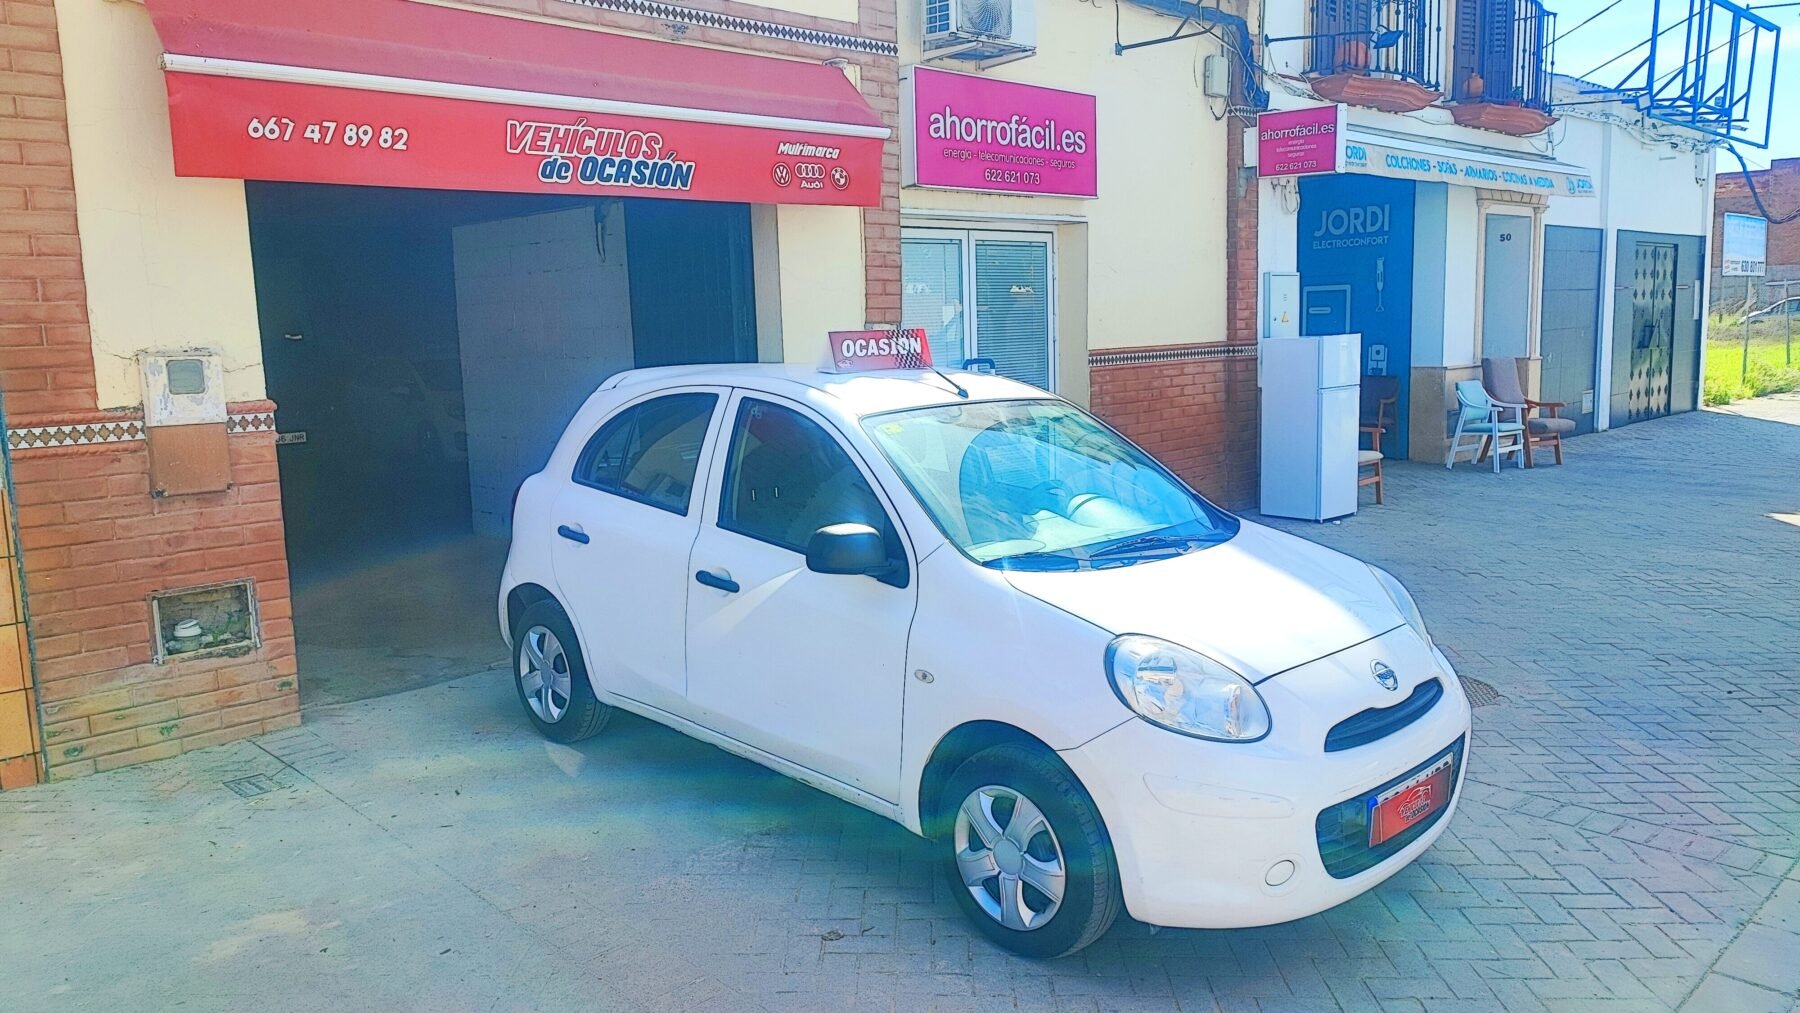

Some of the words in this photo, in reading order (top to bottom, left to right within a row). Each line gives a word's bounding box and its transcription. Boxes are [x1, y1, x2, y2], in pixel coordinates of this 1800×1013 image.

[247, 116, 295, 142] 667
[303, 120, 337, 145] 47
[343, 123, 373, 147] 89
[378, 126, 408, 150] 82
[507, 117, 663, 161] VEHÍCULOS
[929, 106, 1086, 153] ahorrofácil.es
[1261, 122, 1335, 141] ahorrofácil.es
[777, 142, 840, 160] Multimarca
[978, 151, 1045, 166] telecomunicaciones
[1050, 158, 1076, 170] seguros
[1345, 145, 1367, 161] ORDI
[538, 156, 573, 183] de
[577, 151, 697, 191] OCASIÓN
[1275, 163, 1289, 171] 622
[1290, 162, 1302, 170] 621
[1303, 160, 1317, 169] 073
[1385, 153, 1431, 173] COLCHONES
[800, 180, 824, 189] Audi
[985, 168, 1002, 182] 622
[1004, 170, 1020, 183] 621
[1023, 172, 1041, 185] 073
[1313, 203, 1391, 237] JORDI
[1313, 236, 1389, 249] ELECTROCONFORT
[1499, 232, 1512, 242] 50
